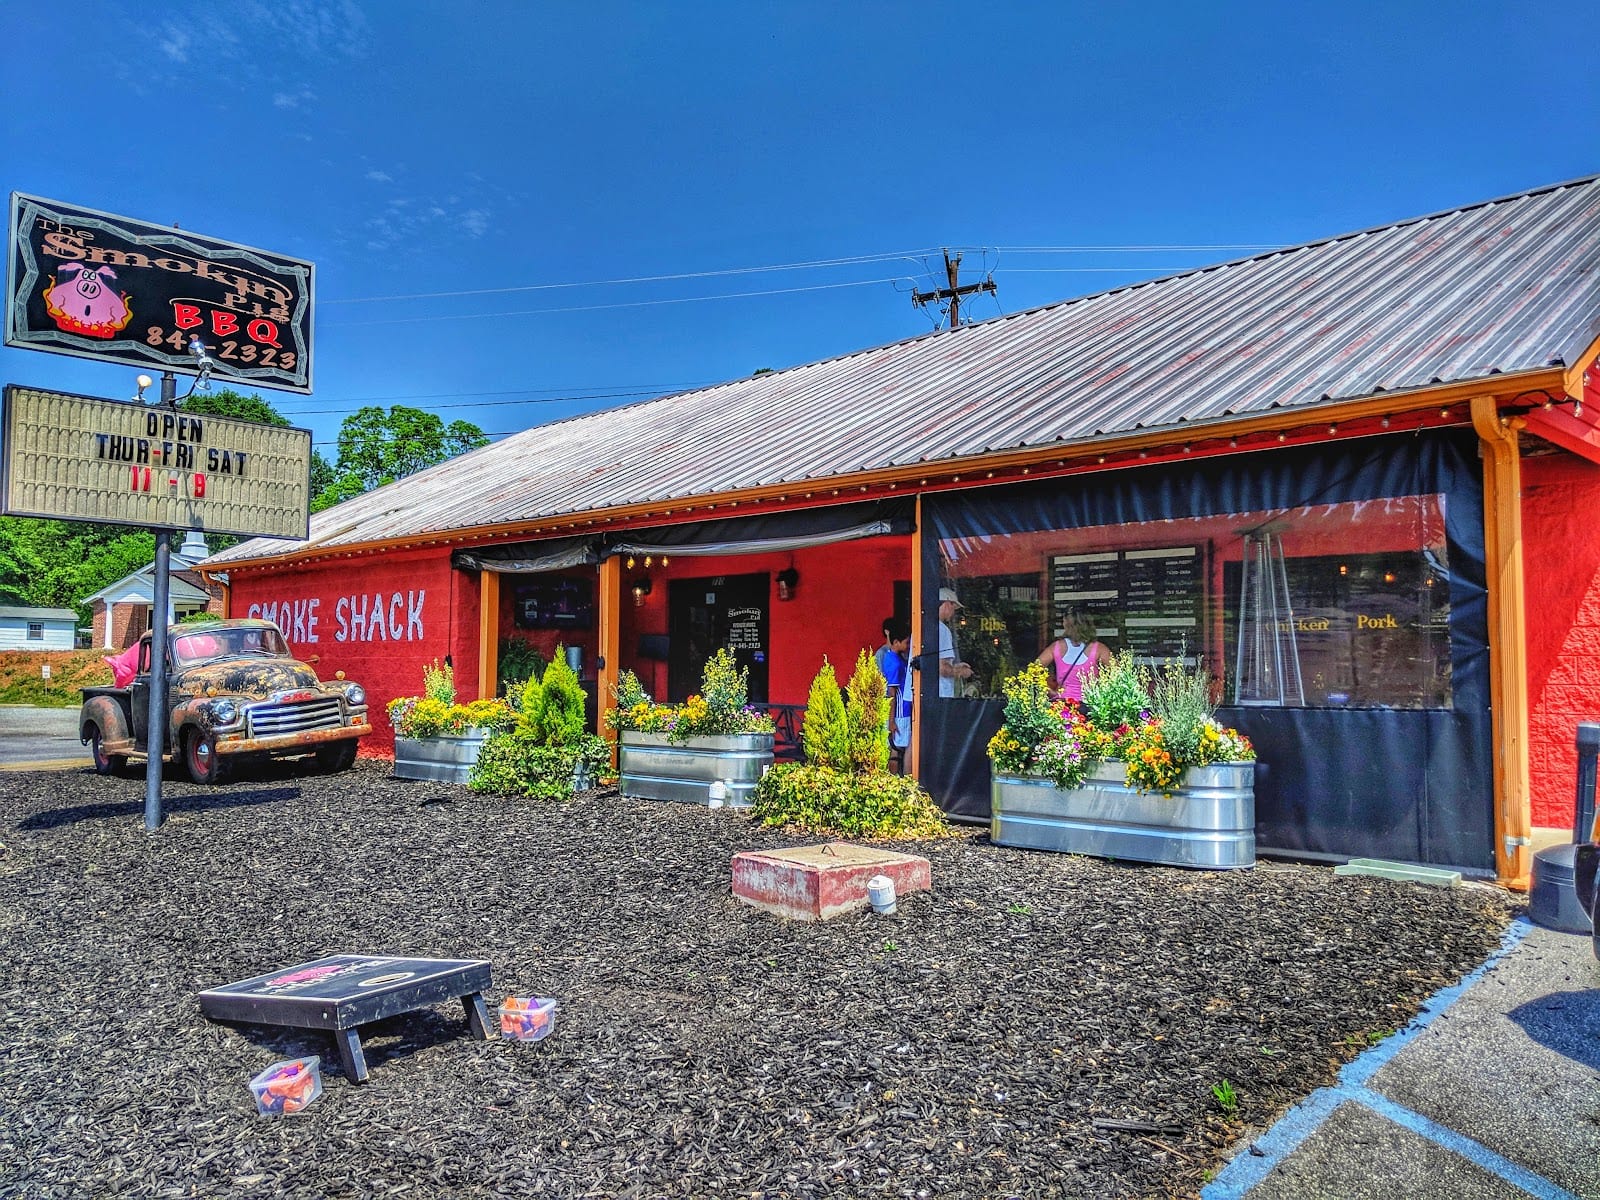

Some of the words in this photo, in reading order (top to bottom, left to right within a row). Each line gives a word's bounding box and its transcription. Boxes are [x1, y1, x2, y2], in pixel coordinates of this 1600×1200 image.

[36, 217, 95, 241] The
[41, 232, 287, 306] Smokin
[174, 303, 283, 349] BBQ
[146, 412, 203, 443] OPEN
[207, 447, 247, 476] SAT
[131, 465, 151, 492] 11
[194, 472, 206, 498] 9
[335, 589, 426, 643] SHACK
[980, 616, 1007, 632] Ribs
[1356, 614, 1399, 630] Pork
